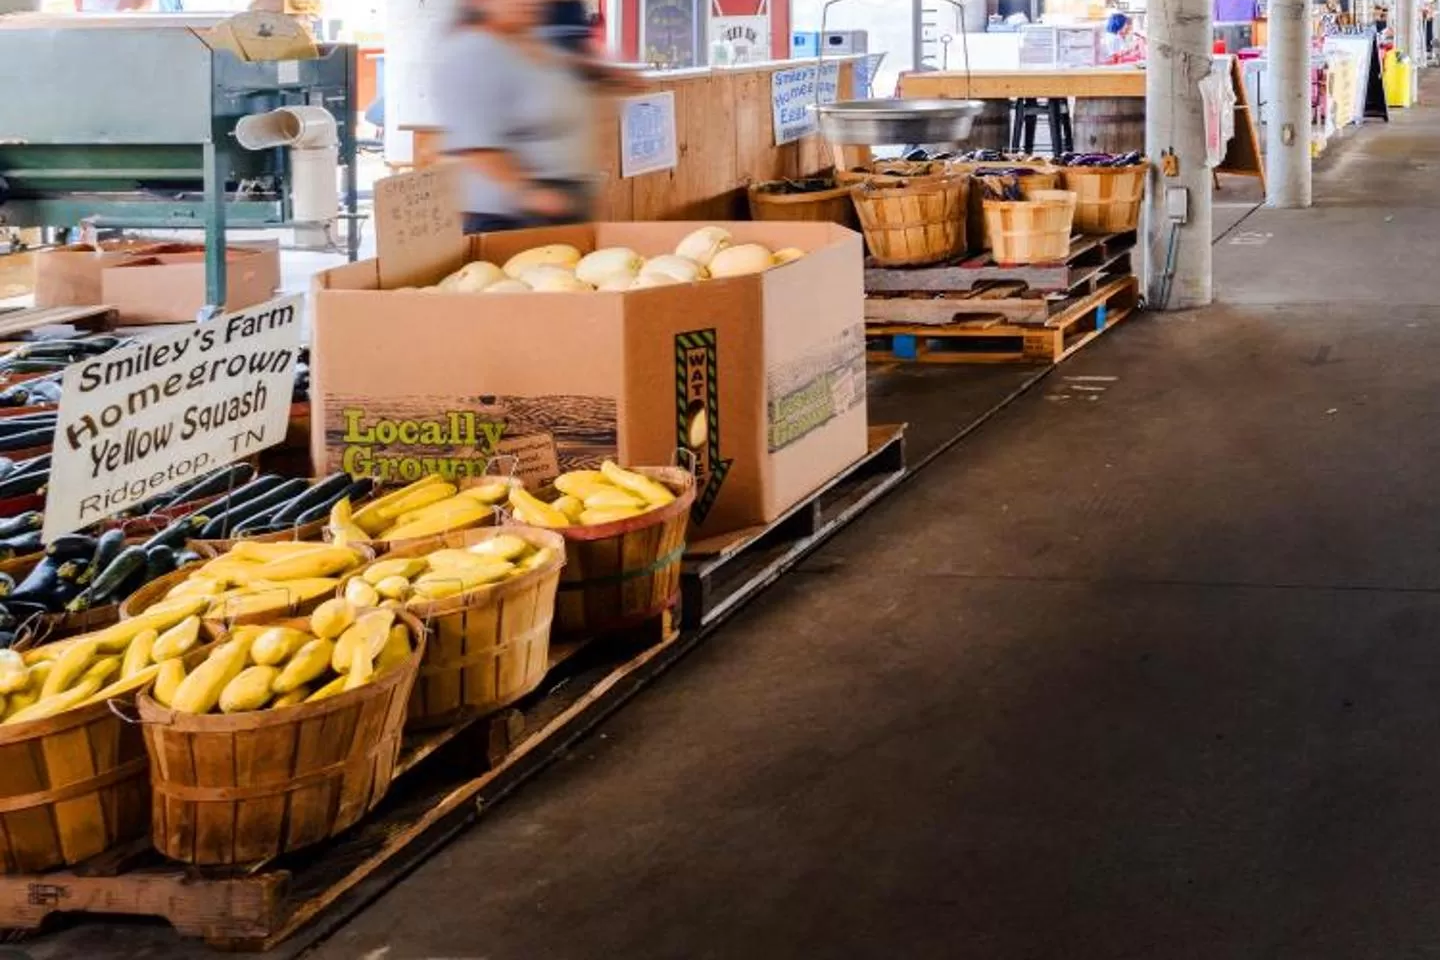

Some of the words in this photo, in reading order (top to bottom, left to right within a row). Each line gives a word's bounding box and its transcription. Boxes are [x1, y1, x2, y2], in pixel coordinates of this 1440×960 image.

[79, 328, 215, 393] Smiley's
[224, 304, 294, 344] Farm
[66, 348, 293, 450] Homegrown
[91, 421, 174, 479] Yellow
[180, 380, 268, 441] Squash
[228, 425, 266, 453] TN
[342, 407, 508, 453] Locally
